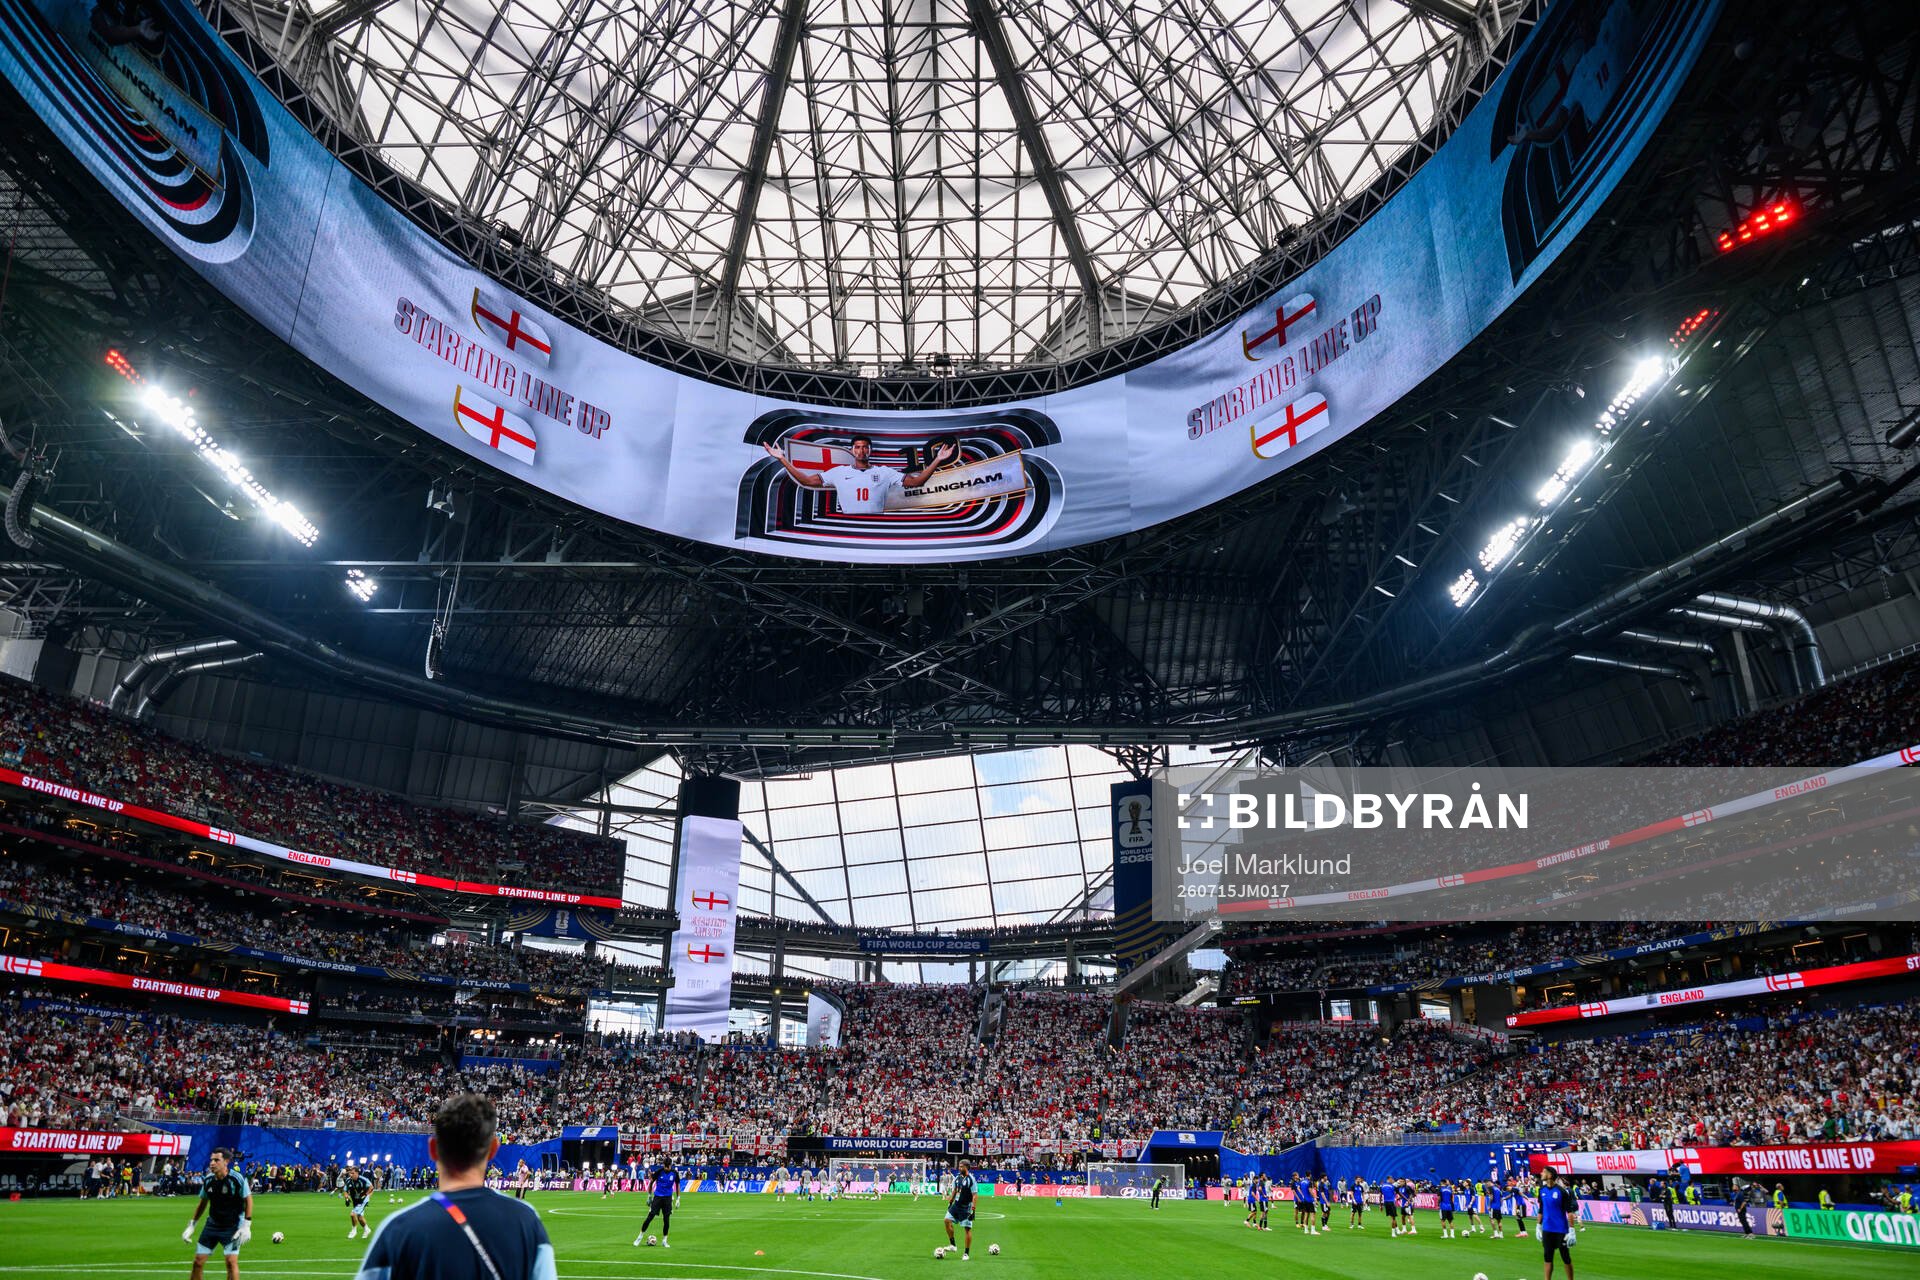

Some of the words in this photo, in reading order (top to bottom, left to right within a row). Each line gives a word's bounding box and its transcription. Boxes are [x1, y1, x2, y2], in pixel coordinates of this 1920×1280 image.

[393, 297, 516, 396] STARTING
[519, 372, 575, 426] LINE
[577, 400, 611, 439] UP
[1187, 356, 1295, 440] STARTING
[1299, 319, 1350, 381] LINE
[1350, 294, 1381, 343] UP
[904, 472, 1003, 497] BELLINGHAM
[856, 487, 869, 501] 10
[22, 776, 80, 800] STARTING
[81, 791, 106, 808] LINE
[106, 800, 124, 813] UP
[1774, 776, 1827, 800] ENGLAND
[287, 850, 331, 867] ENGLAND
[1120, 854, 1153, 864] 2026
[1536, 850, 1576, 869] STARTING
[1576, 844, 1597, 857] LINE
[1597, 839, 1611, 851] UP
[498, 887, 543, 899] STARTING
[545, 892, 566, 902] LINE
[567, 894, 581, 903] UP
[1347, 888, 1389, 901] ENGLAND
[867, 940, 887, 949] FIFA
[888, 940, 925, 949] WORLD
[925, 940, 945, 949] CUP
[946, 940, 980, 949] 2026
[1636, 938, 1686, 954] ATLANTA
[283, 955, 296, 964] FIFA
[296, 957, 317, 968] WORLD
[317, 960, 332, 969] CUP
[332, 963, 356, 972] 2026
[1514, 968, 1533, 977] 2026
[132, 978, 182, 995] STARTING
[184, 985, 206, 998] LINE
[206, 989, 220, 1000] UP
[461, 979, 511, 989] ATLANTA
[1659, 989, 1704, 1005] ENGLAND
[1506, 1015, 1517, 1026] UP
[12, 1131, 78, 1149] STARTING
[78, 1134, 104, 1150] LINE
[105, 1136, 123, 1150] UP
[832, 1139, 856, 1148] FIFA
[856, 1139, 889, 1149] WORLD
[889, 1140, 909, 1149] CUP
[909, 1140, 943, 1149] 2026
[1596, 1154, 1636, 1171] ENGLAND
[1743, 1149, 1810, 1171] STARTING
[1810, 1148, 1848, 1170] LINE
[1851, 1147, 1875, 1169] UP
[1140, 1188, 1187, 1198] HYNDAI
[1651, 1208, 1668, 1221] FIFA
[1673, 1209, 1699, 1224] ORLD
[1700, 1210, 1718, 1225] CUP
[1791, 1213, 1847, 1237] BANK
[1846, 1212, 1920, 1245] aram
